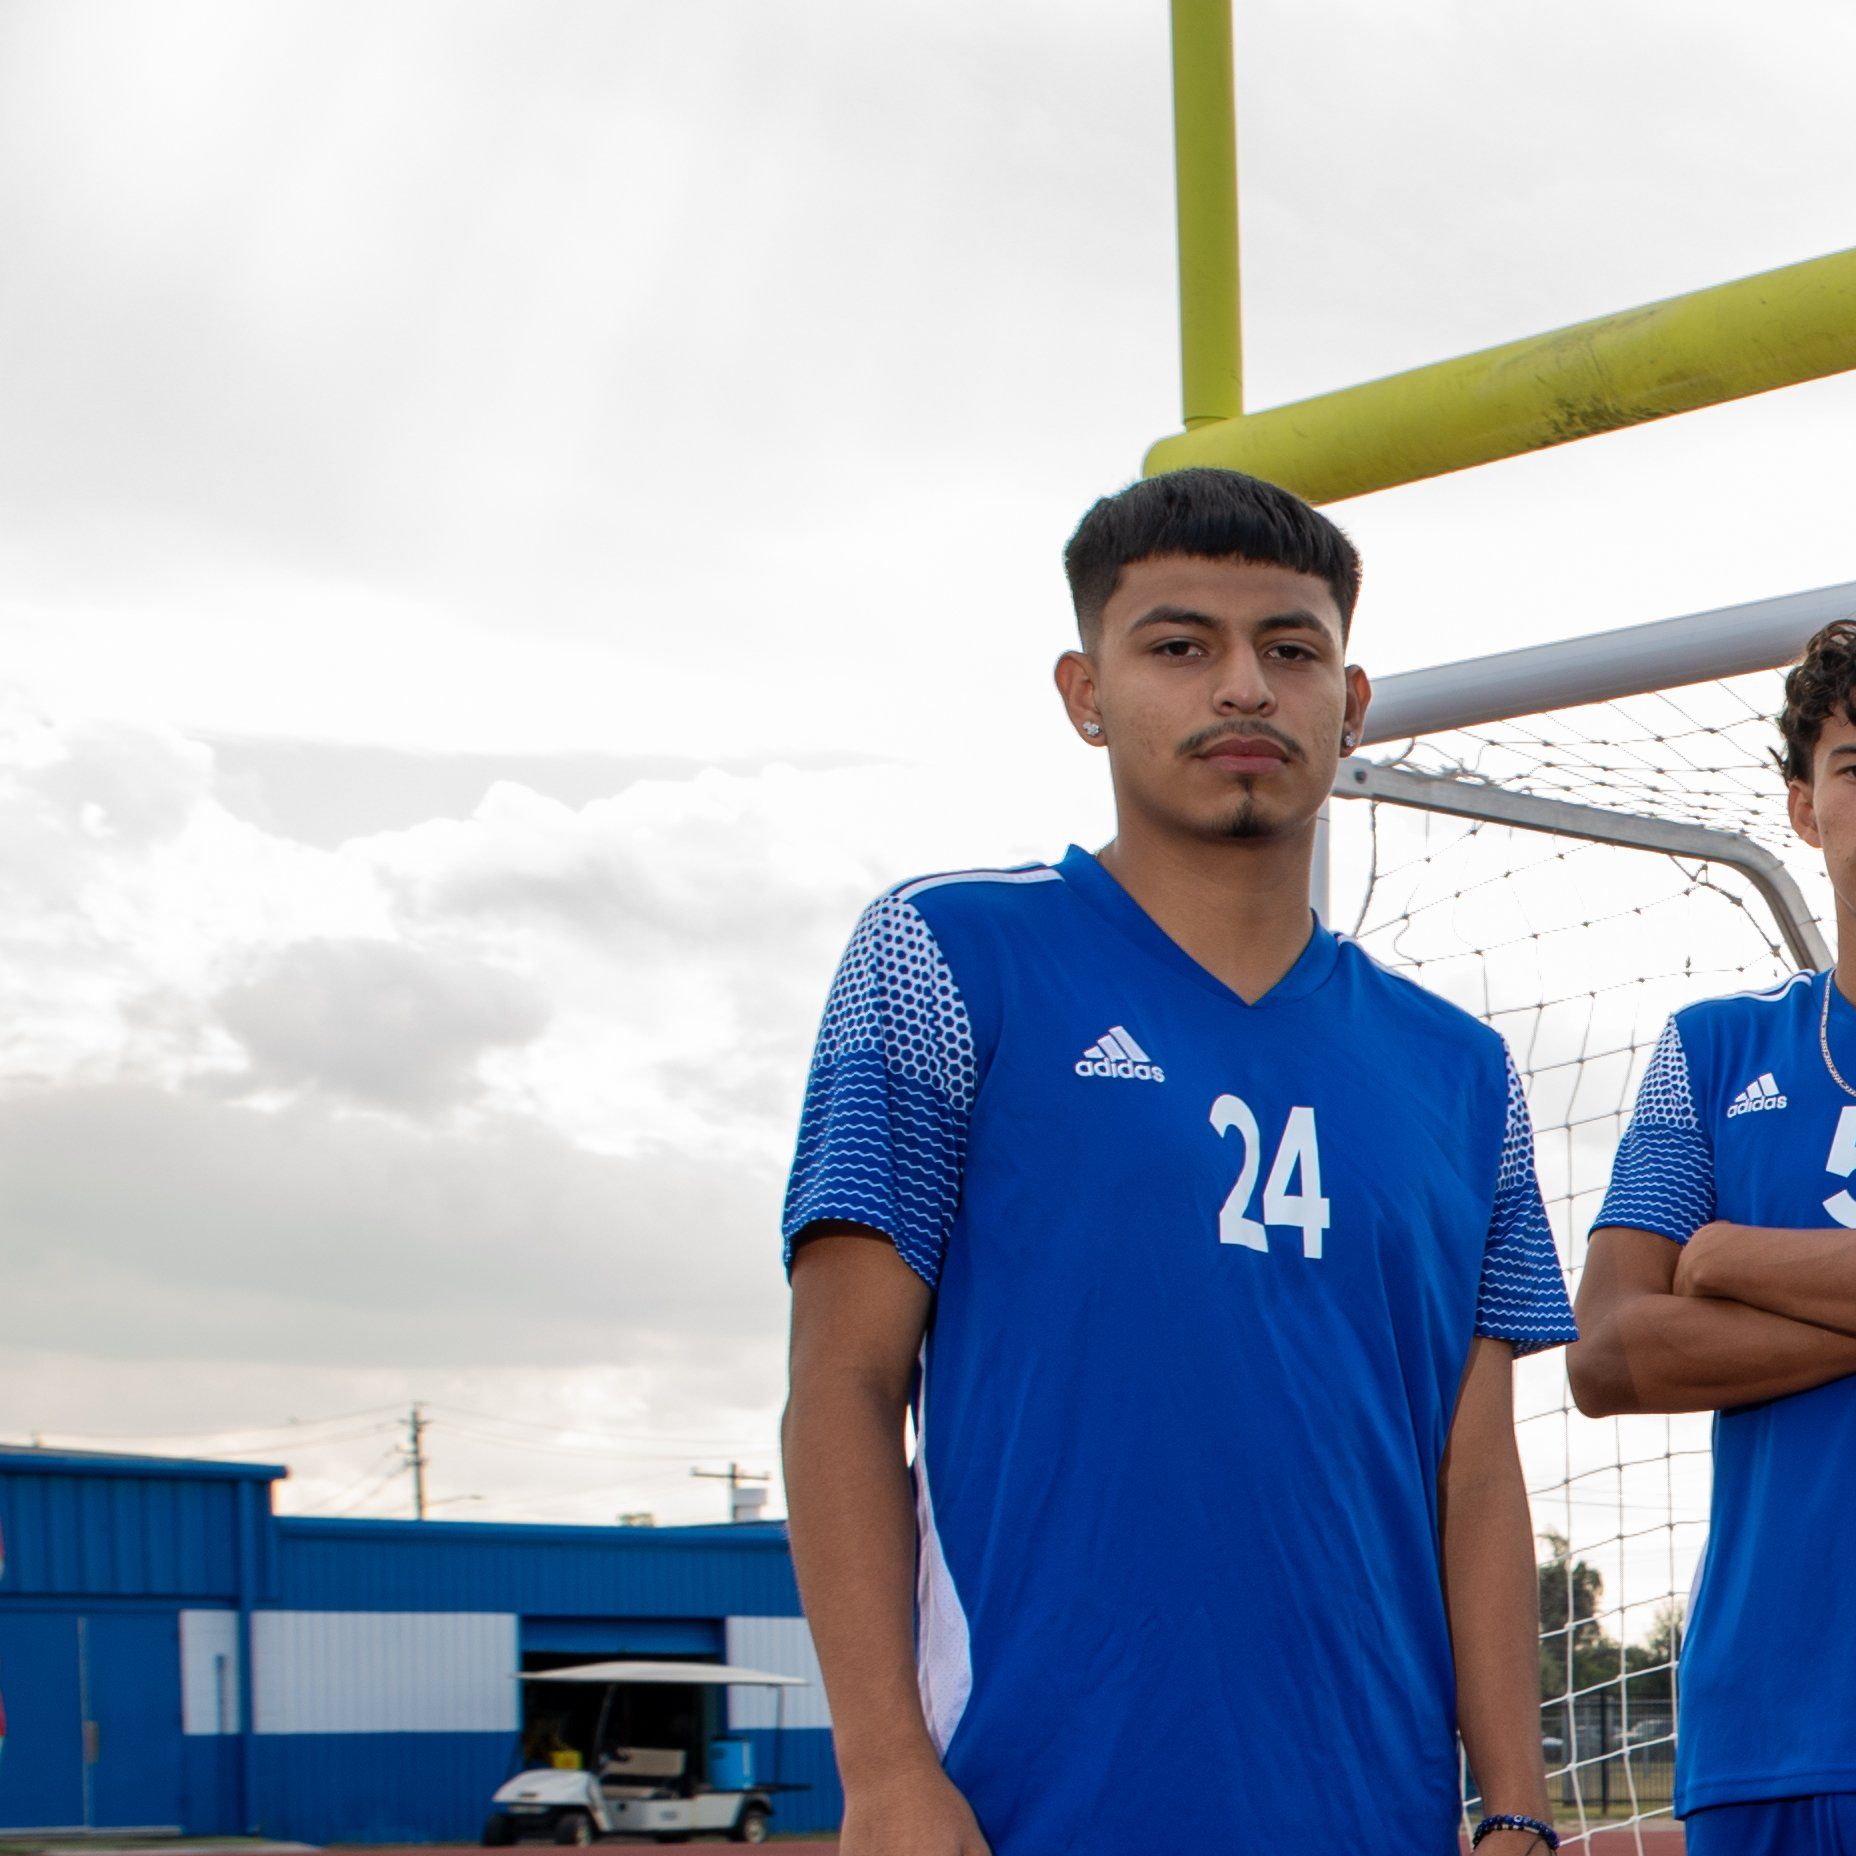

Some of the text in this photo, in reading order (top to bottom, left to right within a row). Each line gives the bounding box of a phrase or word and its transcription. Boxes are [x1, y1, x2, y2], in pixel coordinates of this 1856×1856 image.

[1075, 1056, 1165, 1083] adidas
[1727, 1095, 1788, 1118] adidas
[1209, 1094, 1330, 1259] 24
